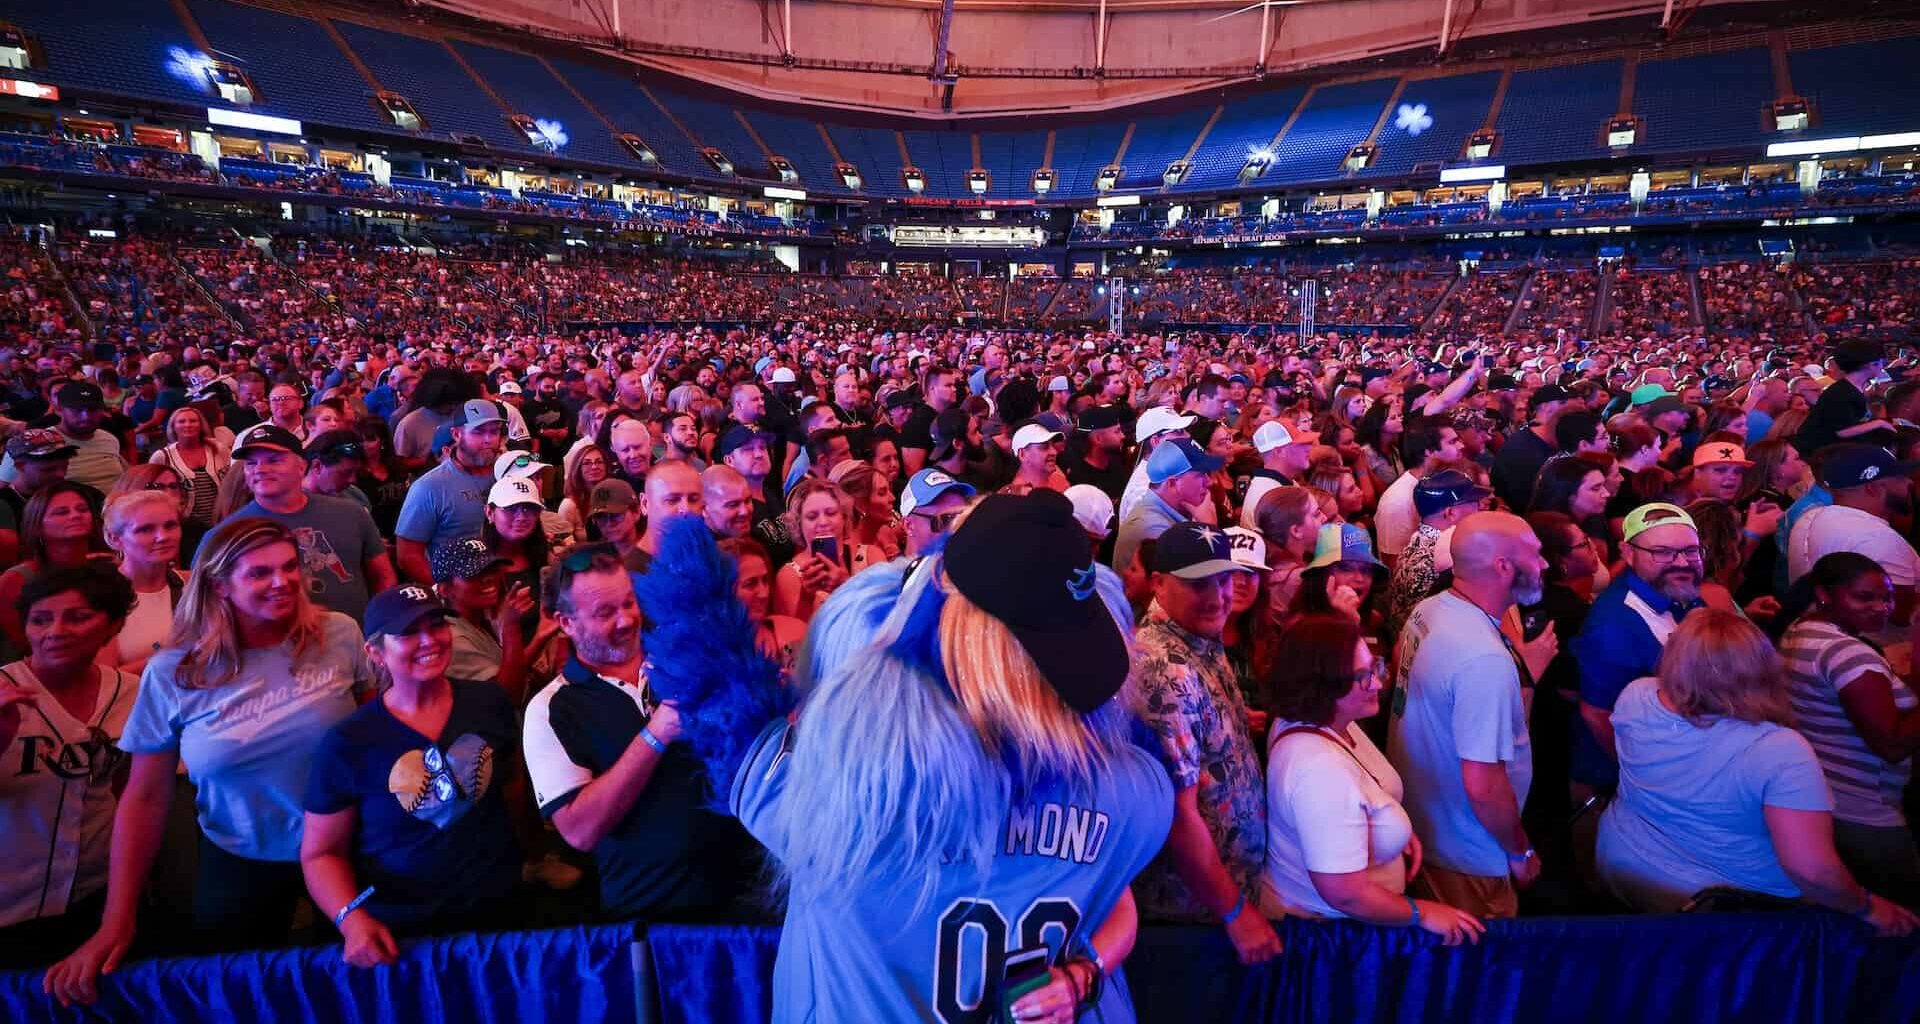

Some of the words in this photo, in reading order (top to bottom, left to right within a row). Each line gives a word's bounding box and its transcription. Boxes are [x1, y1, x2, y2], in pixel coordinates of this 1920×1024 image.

[513, 482, 530, 493] TB
[465, 539, 487, 551] TB
[400, 586, 428, 600] TB
